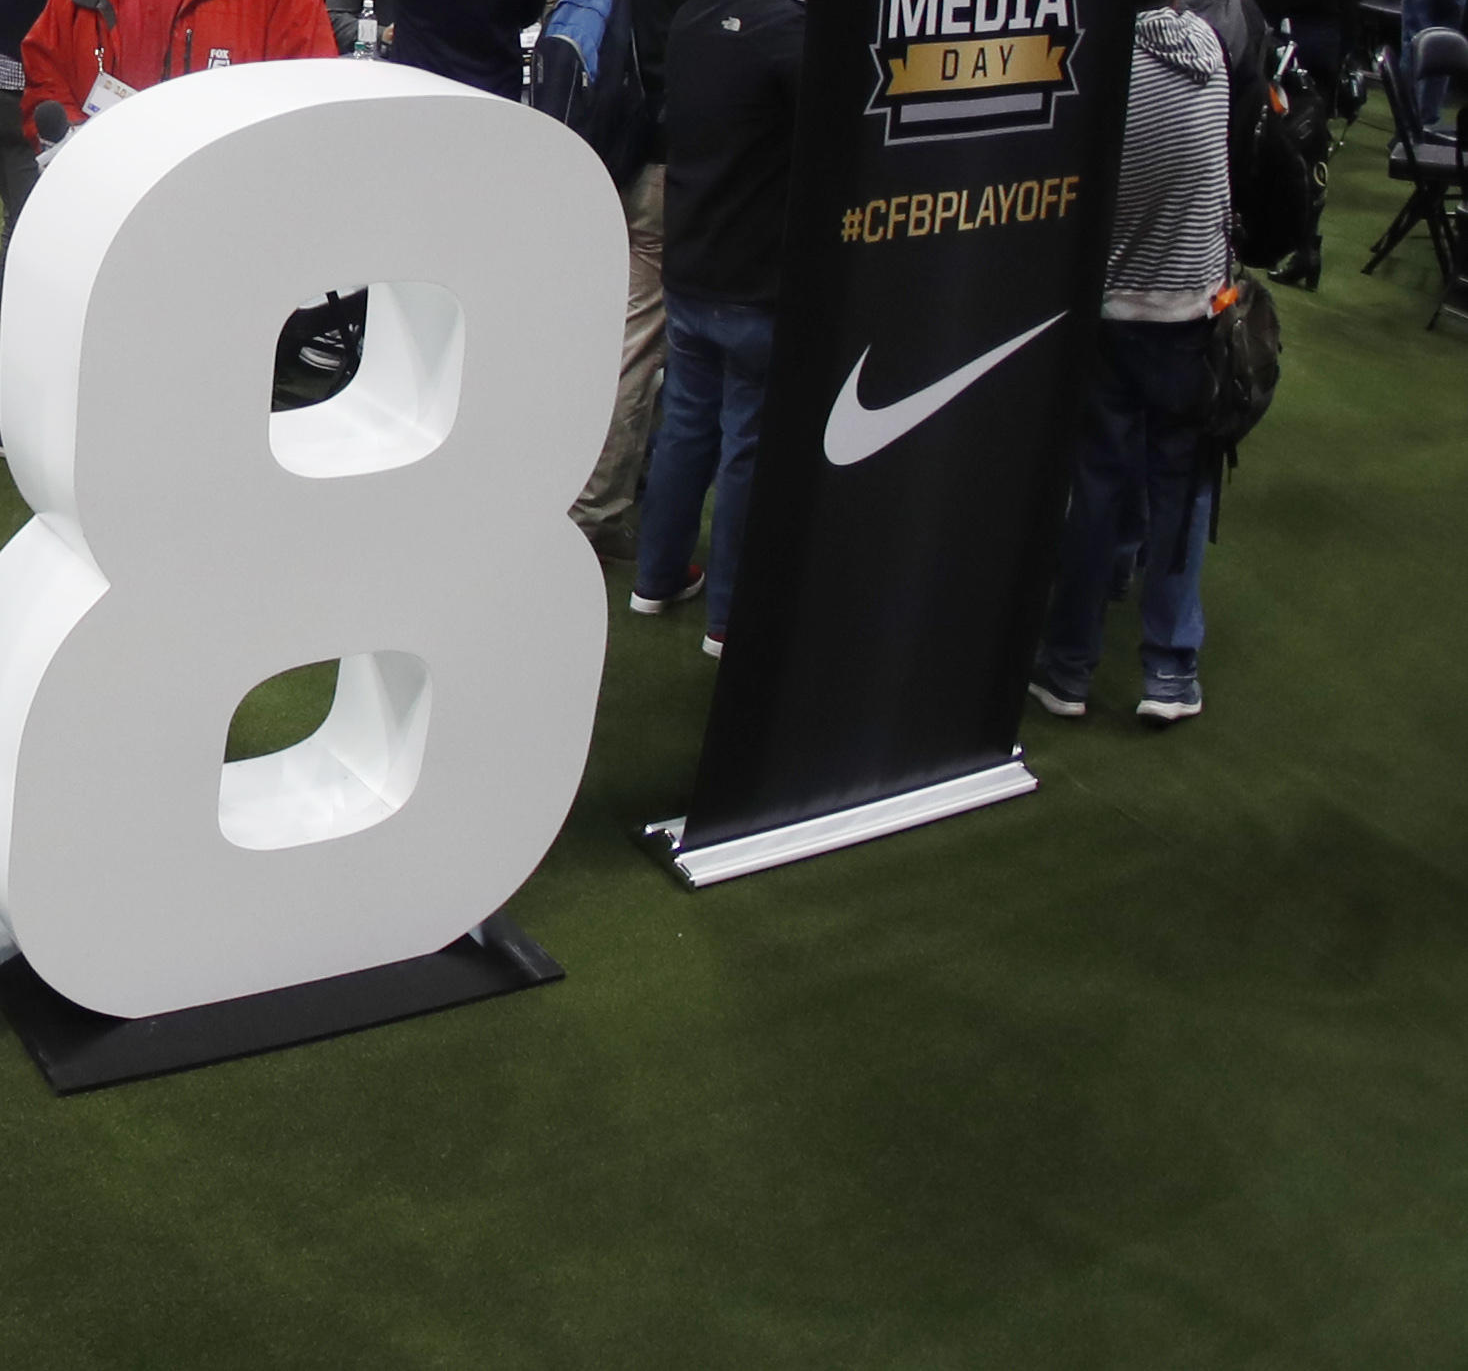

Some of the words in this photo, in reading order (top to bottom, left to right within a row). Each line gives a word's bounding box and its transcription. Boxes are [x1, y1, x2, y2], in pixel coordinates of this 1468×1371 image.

[209, 48, 230, 59] FOX
[940, 44, 1015, 81] DAY
[839, 175, 1080, 245] #CFBPLAYOFF
